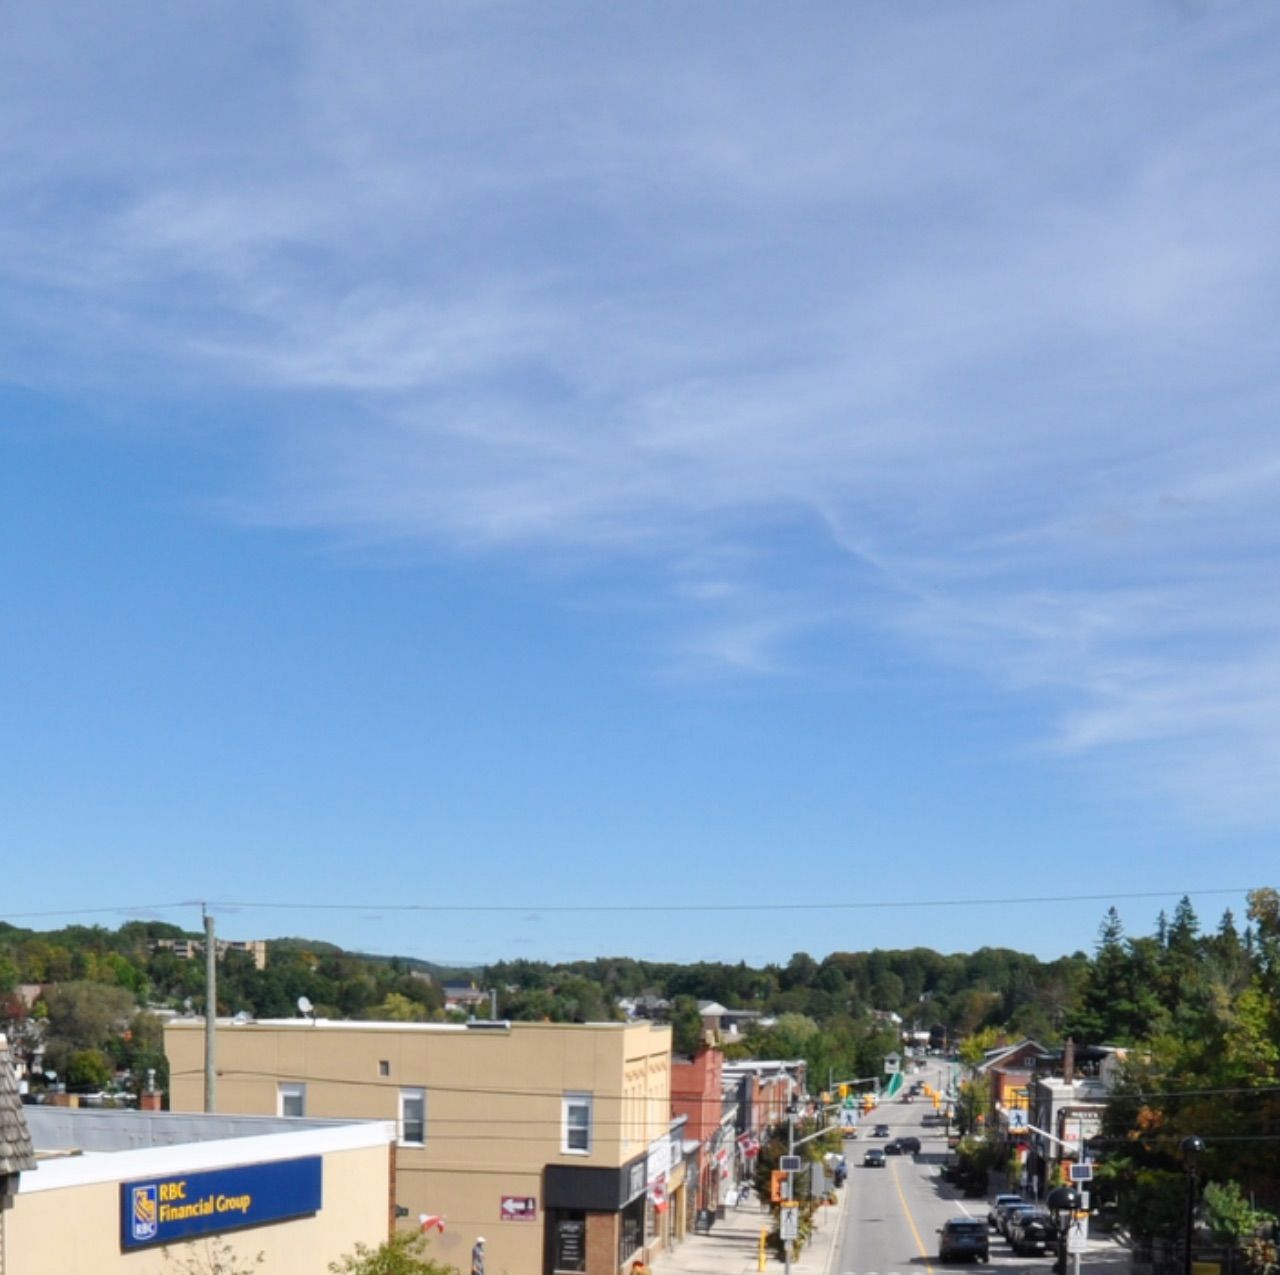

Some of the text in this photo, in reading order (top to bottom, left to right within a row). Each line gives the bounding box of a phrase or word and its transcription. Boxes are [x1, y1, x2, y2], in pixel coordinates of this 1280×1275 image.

[159, 1181, 187, 1201] RBC
[160, 1194, 252, 1223] Financial Group
[136, 1222, 156, 1235] RBC
